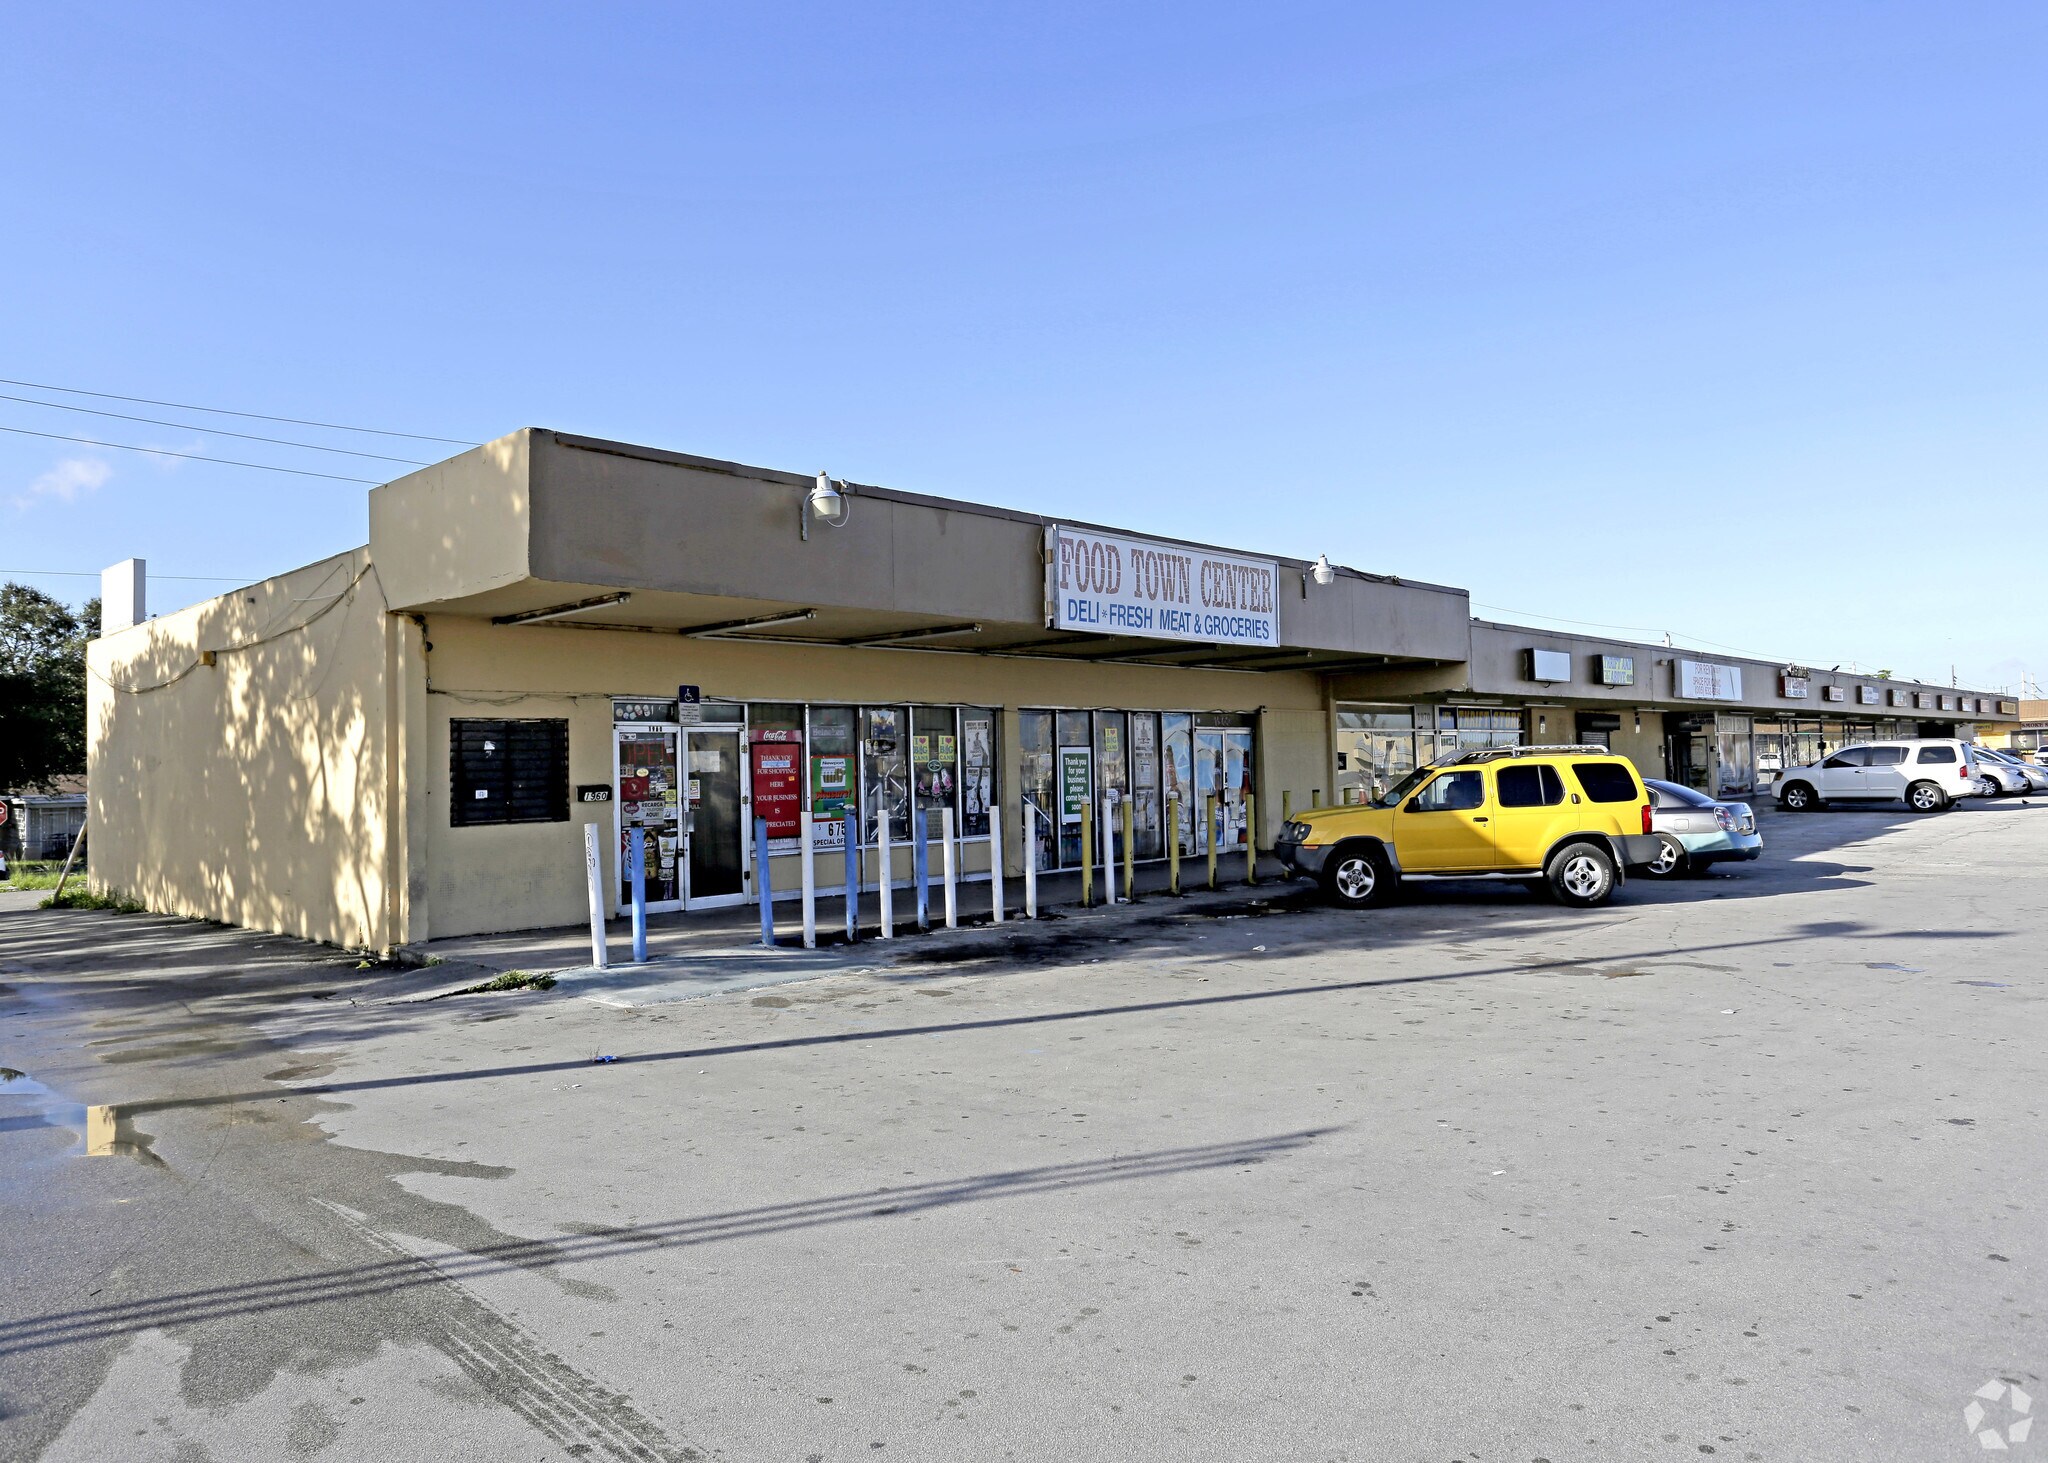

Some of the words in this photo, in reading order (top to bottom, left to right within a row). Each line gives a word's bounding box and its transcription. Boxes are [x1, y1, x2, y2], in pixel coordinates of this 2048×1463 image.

[1059, 537, 1121, 594] FOOD
[1131, 548, 1192, 604] TOWN
[1200, 559, 1273, 614] CENTER
[1068, 598, 1099, 623] DELI
[1109, 603, 1153, 629] FRESH
[1160, 609, 1192, 634] MEAT
[1194, 613, 1202, 634] &
[1204, 614, 1270, 640] GROCERIES
[1417, 712, 1431, 721] 1970
[1459, 710, 1490, 728] THRIFT
[1493, 711, 1522, 729] STORE
[1065, 758, 1078, 766] Thank
[1075, 768, 1085, 777] your
[1070, 785, 1084, 794] please
[584, 792, 608, 800] 1960
[815, 789, 852, 800] pleasure!
